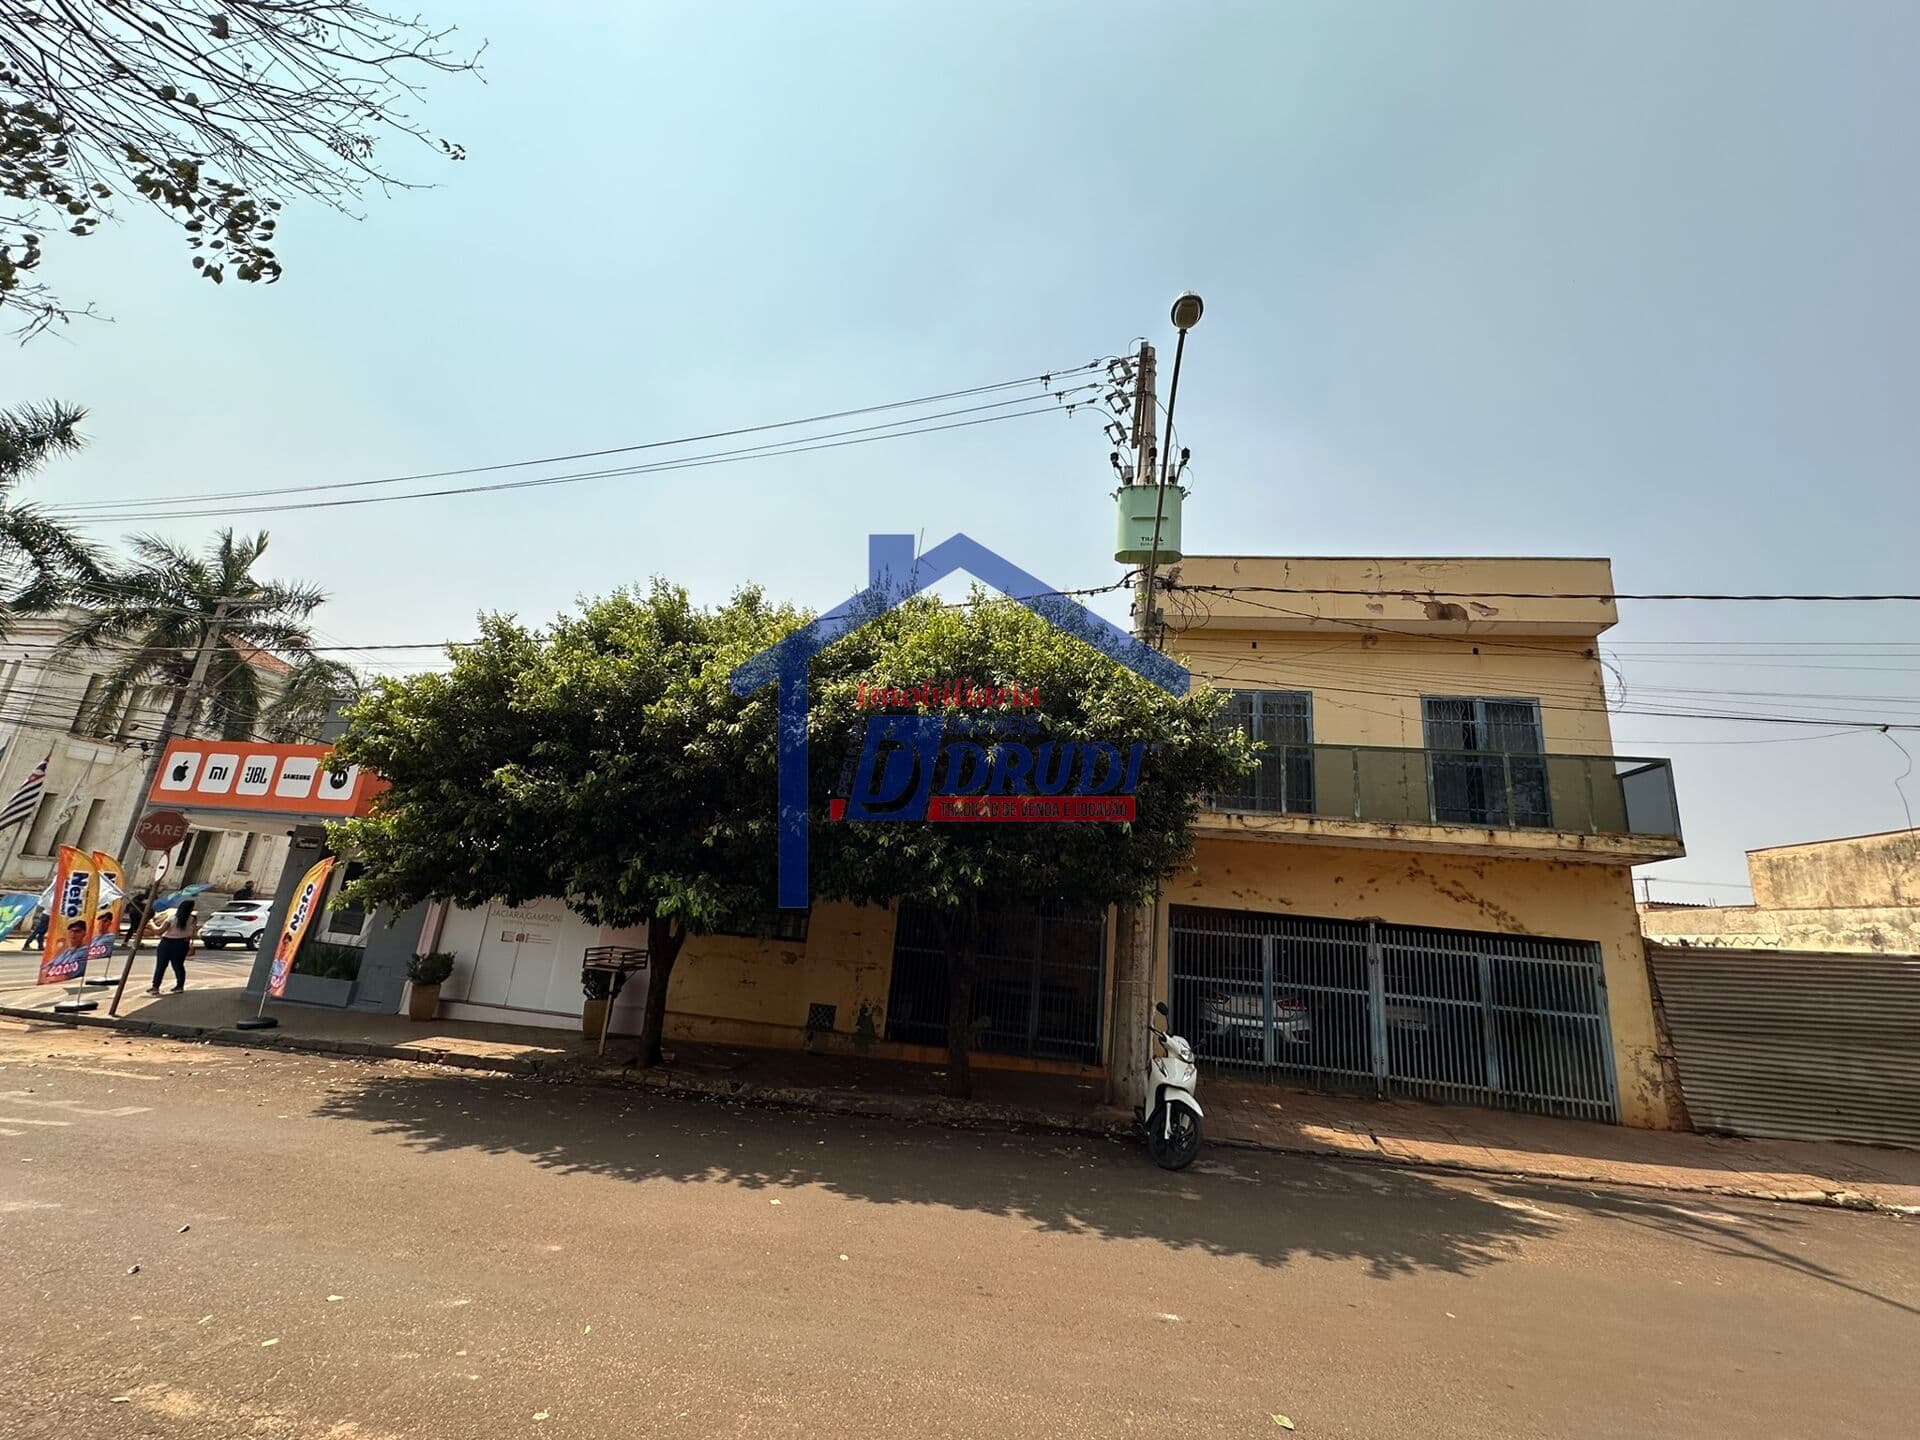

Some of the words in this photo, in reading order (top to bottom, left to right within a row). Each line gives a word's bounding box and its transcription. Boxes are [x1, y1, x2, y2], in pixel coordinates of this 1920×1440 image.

[245, 766, 267, 784] JBL
[283, 772, 311, 782] SAMSUNG
[142, 822, 183, 838] PARE
[67, 872, 89, 918] Neto
